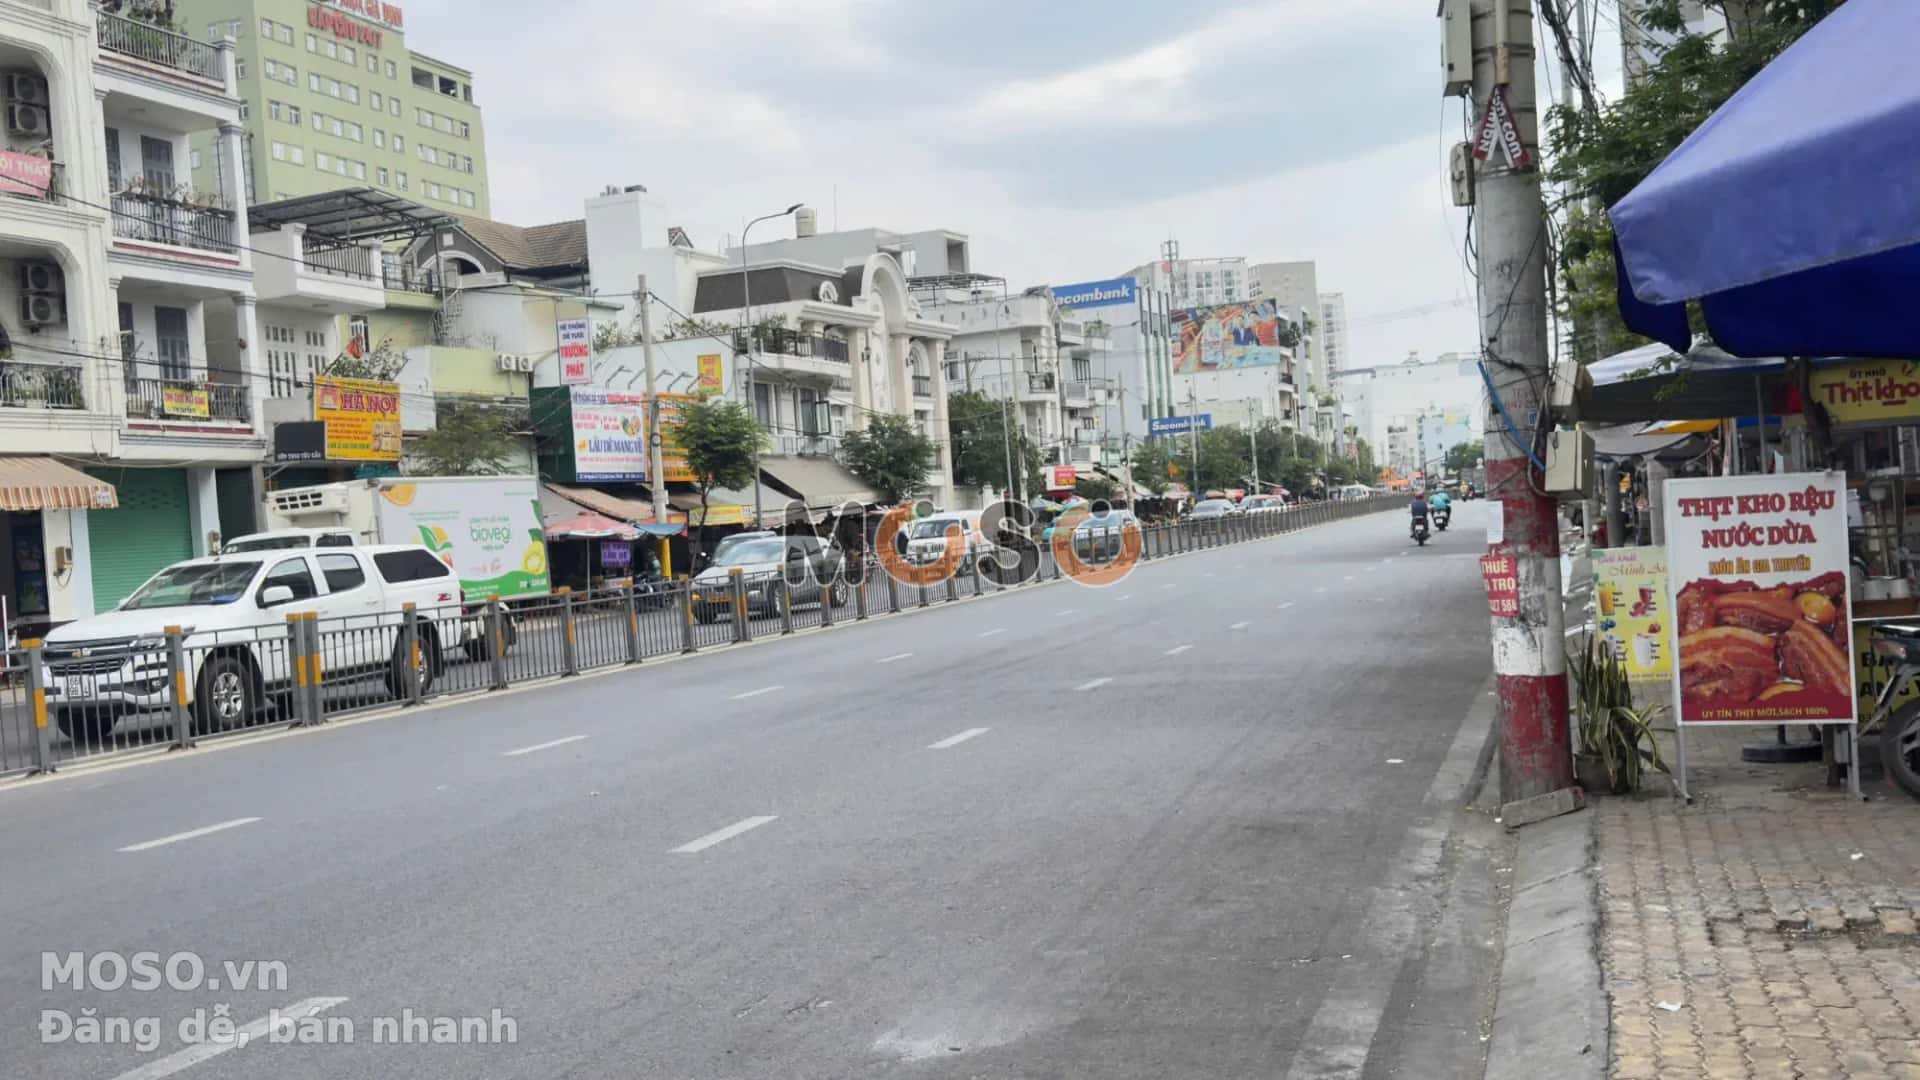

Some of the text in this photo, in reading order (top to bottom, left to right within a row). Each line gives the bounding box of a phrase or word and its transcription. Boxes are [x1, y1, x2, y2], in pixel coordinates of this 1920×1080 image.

[1055, 283, 1131, 306] acombank
[342, 389, 398, 418] HÀ NỘI
[1820, 376, 1920, 407] Thịt kho
[1152, 417, 1207, 431] Sacombk
[1679, 485, 1836, 522] THỊT KHO RỆU
[1702, 518, 1817, 548] NƯỚC DỪA
